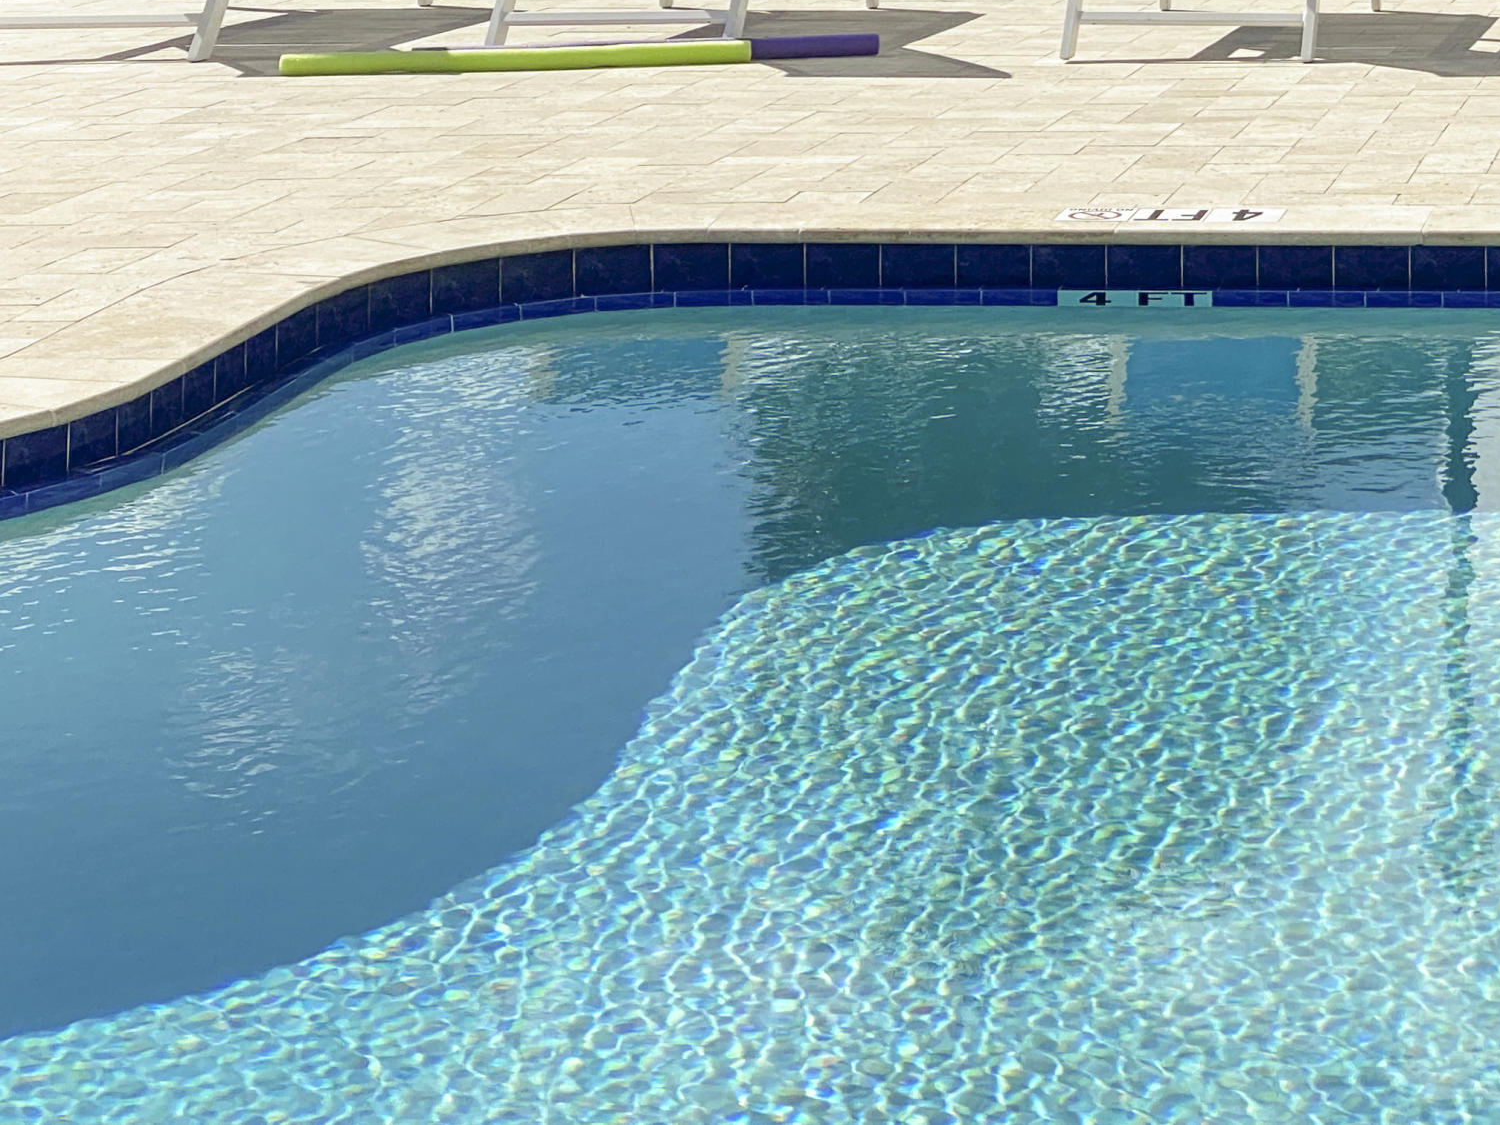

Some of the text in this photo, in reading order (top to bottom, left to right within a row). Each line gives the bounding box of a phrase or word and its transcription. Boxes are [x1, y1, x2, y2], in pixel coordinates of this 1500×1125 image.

[1133, 209, 1263, 221] 4 FT
[1079, 291, 1207, 306] 4 FT
